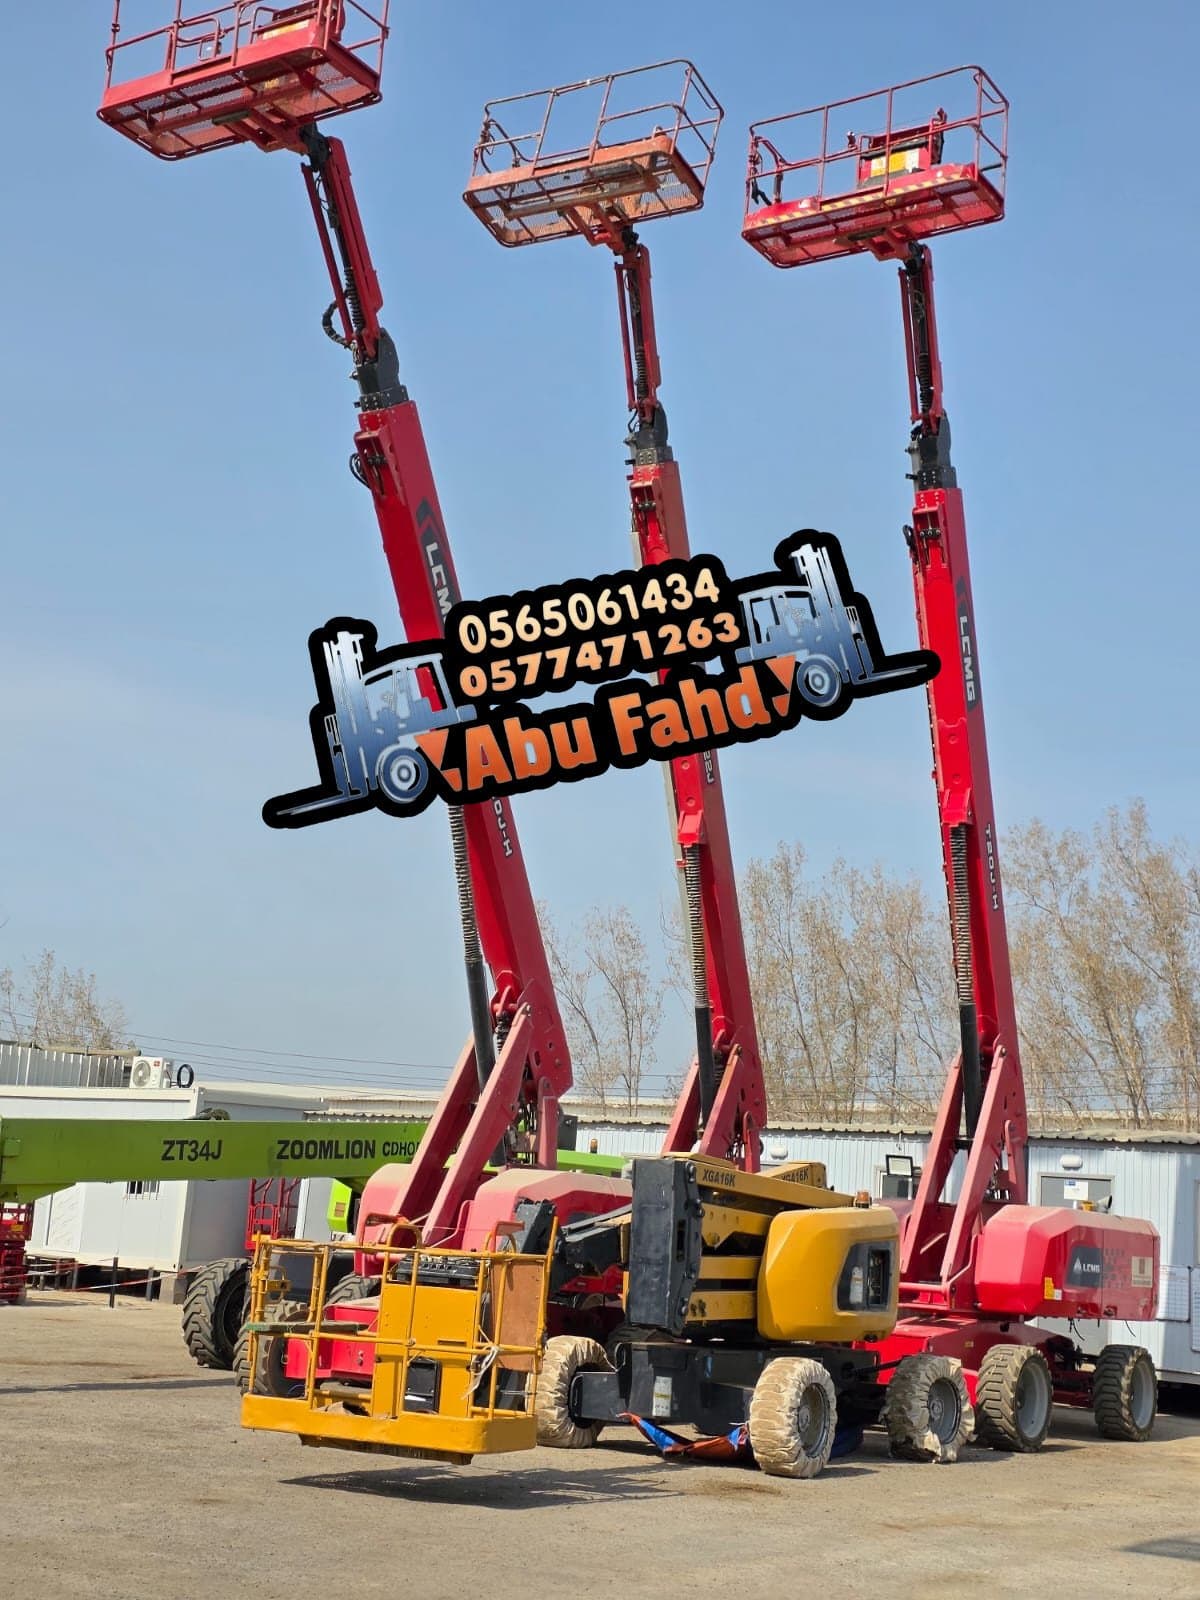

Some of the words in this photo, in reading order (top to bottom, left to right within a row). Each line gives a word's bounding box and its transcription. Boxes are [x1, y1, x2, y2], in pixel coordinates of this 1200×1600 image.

[491, 796, 513, 857] 0J-H
[161, 1139, 223, 1162] ZT34J
[276, 1139, 376, 1160] ZOOMLION
[702, 1168, 736, 1188] XGA16K
